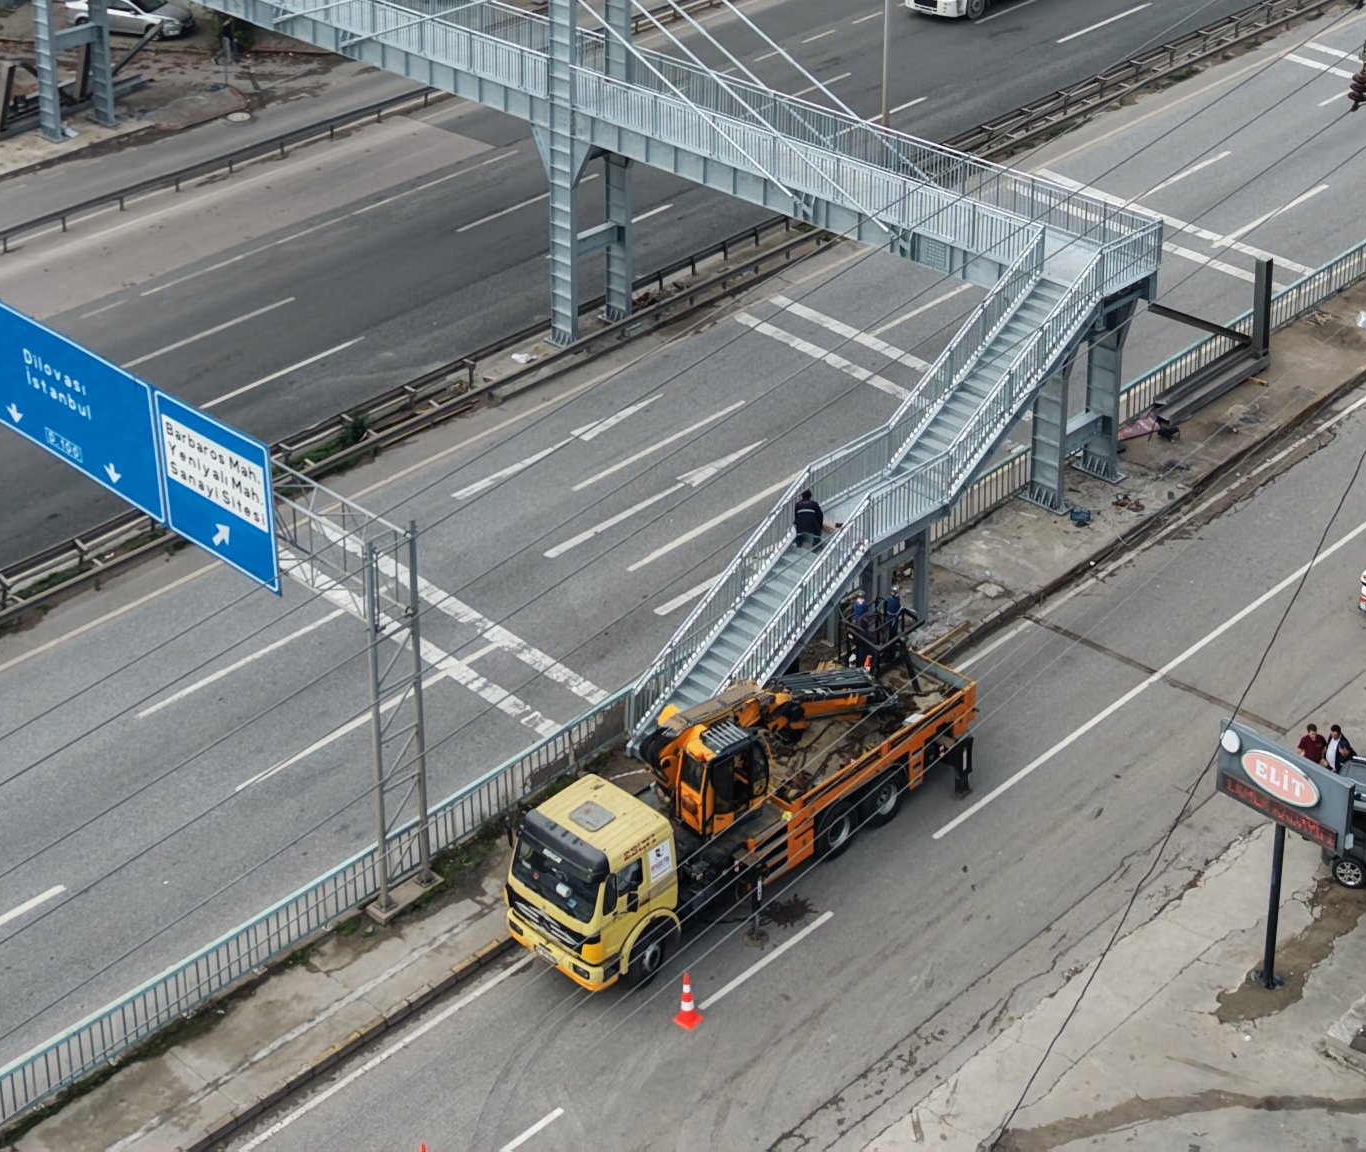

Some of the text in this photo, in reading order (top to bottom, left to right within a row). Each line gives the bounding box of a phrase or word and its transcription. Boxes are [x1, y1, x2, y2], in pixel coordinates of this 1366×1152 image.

[22, 348, 86, 397] Dilovası
[26, 365, 92, 420] İstanbul
[165, 421, 261, 485] Barbaros Mah.
[170, 461, 266, 527] Sanayi Sitesi
[231, 476, 264, 506] Mah.
